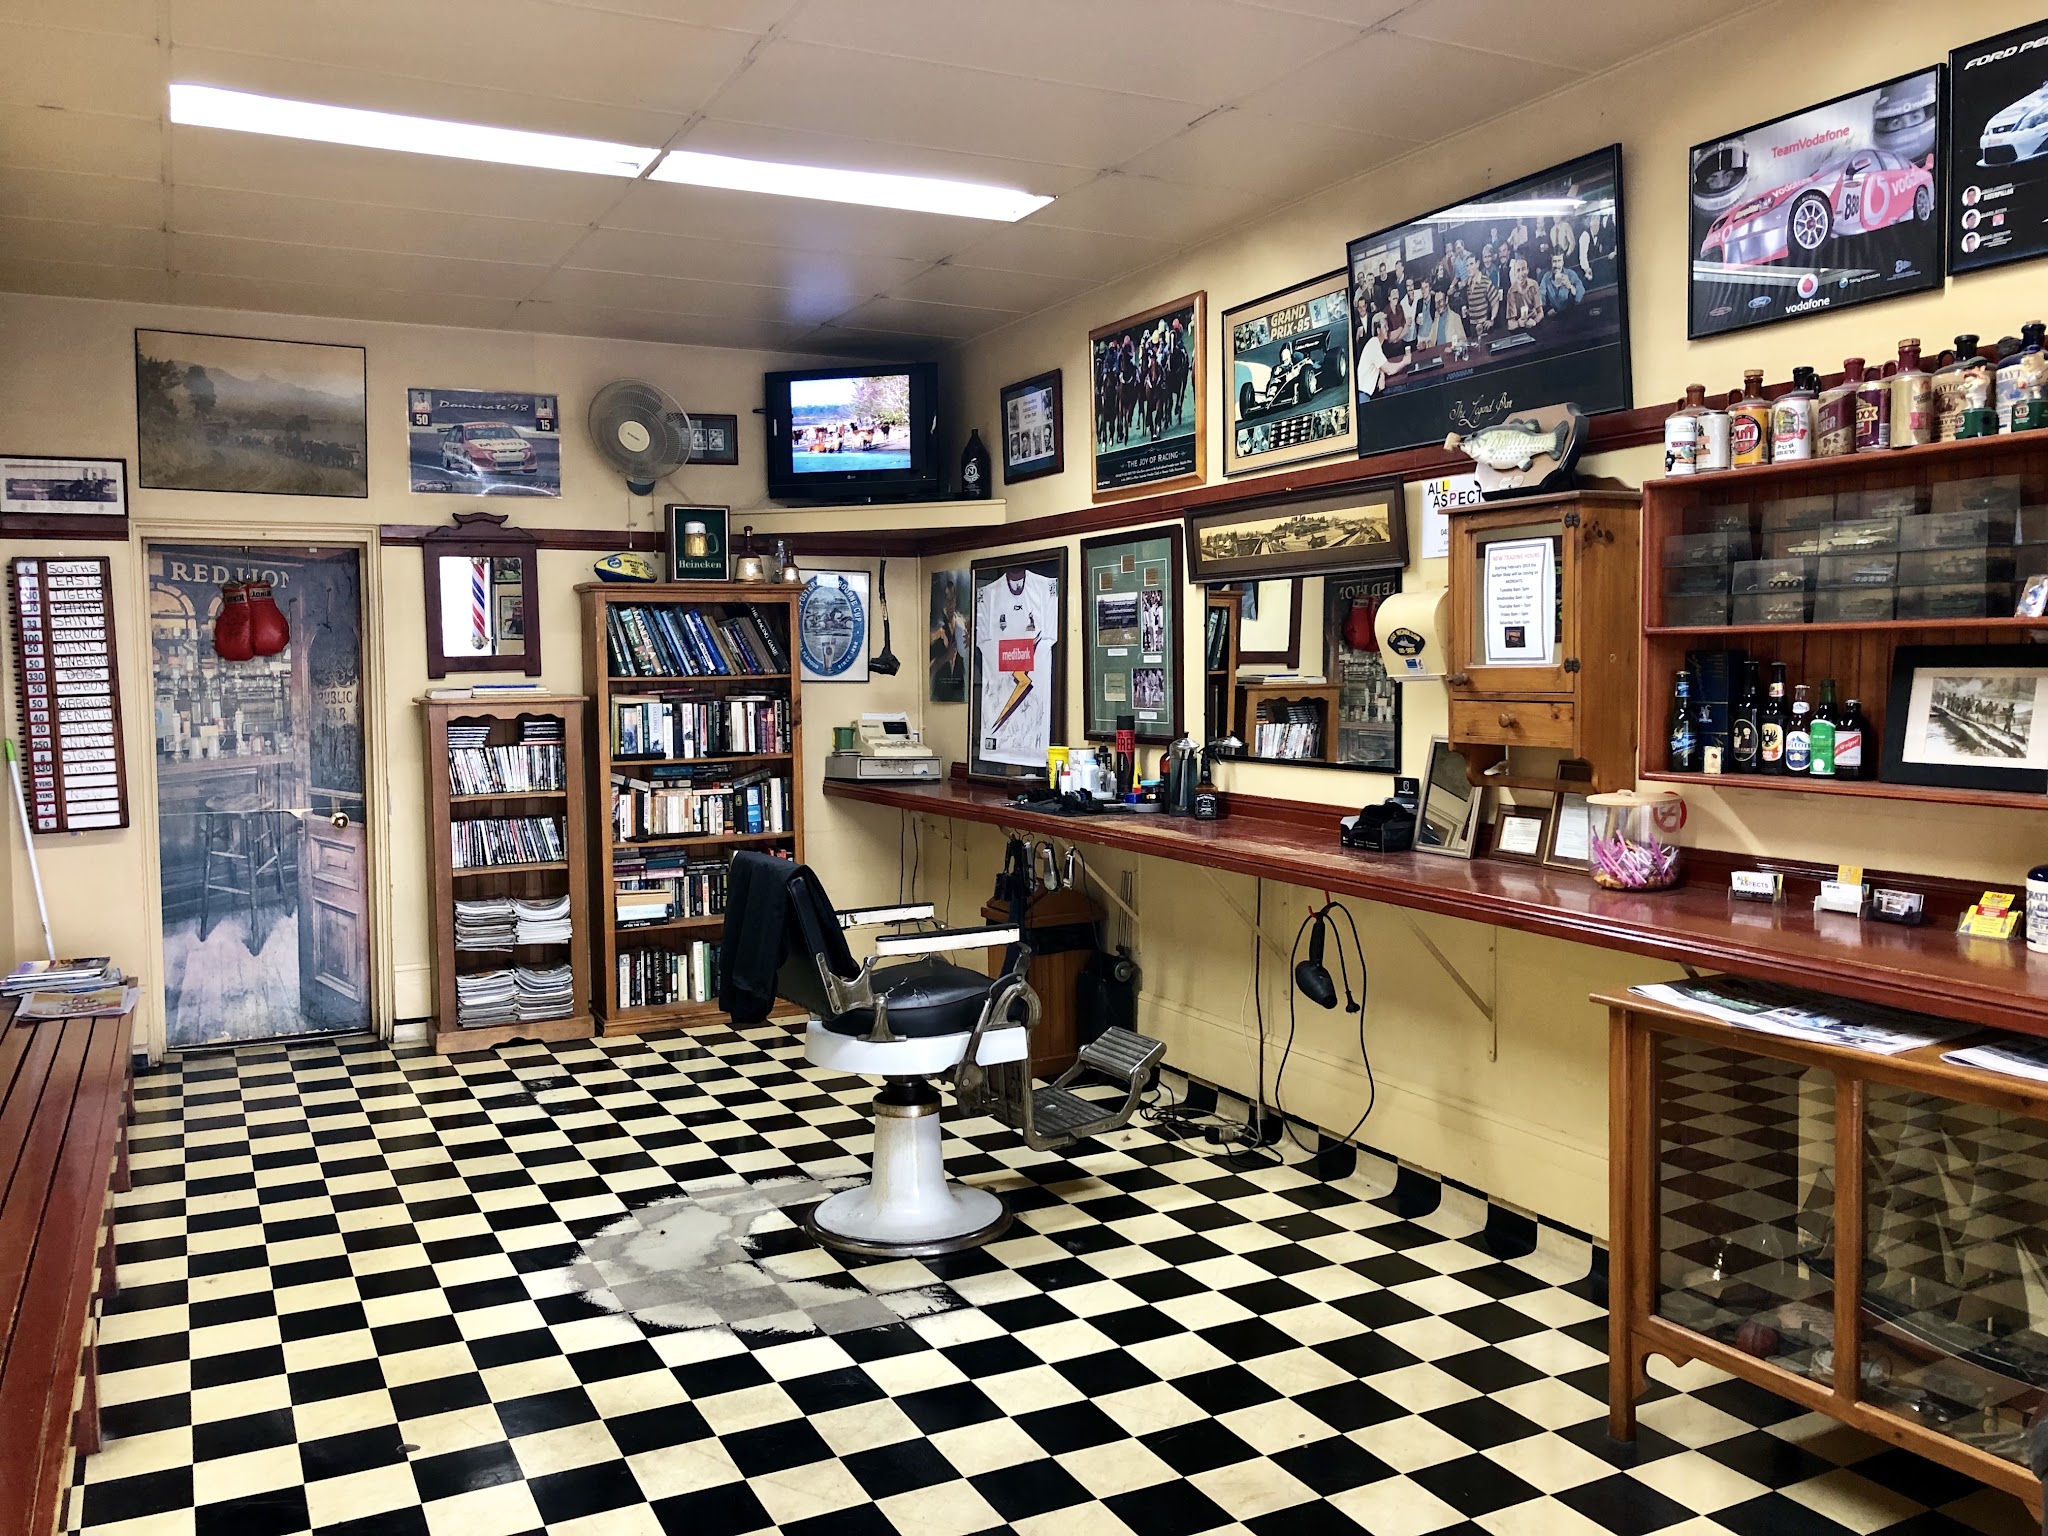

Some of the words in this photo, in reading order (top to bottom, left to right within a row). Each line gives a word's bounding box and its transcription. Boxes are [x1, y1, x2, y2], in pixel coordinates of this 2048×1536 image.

[1964, 46, 2018, 71] FORD
[1771, 126, 1850, 159] TeamVodafone
[1785, 296, 1831, 314] vodafone
[1270, 304, 1307, 328] GRAND
[416, 413, 429, 426] 50
[539, 419, 551, 431] 15
[1127, 459, 1138, 469] THE
[1138, 457, 1148, 467] JOY
[1149, 455, 1157, 464] OF
[1157, 451, 1179, 463] RACING
[1427, 480, 1449, 496] ALL
[1432, 490, 1482, 508] ASPECT
[48, 564, 99, 574] SOUTHS
[678, 559, 722, 569] Heineken
[170, 561, 230, 584] RED
[56, 576, 103, 587] EASTS
[54, 589, 104, 600] TIGERS
[26, 620, 37, 629] 33
[54, 615, 106, 627] SAINTS
[632, 610, 657, 660] MANDELA
[756, 618, 770, 640] RACING
[24, 634, 39, 642] 100
[27, 644, 39, 653] 50
[1002, 647, 1031, 661] medibank
[29, 660, 40, 668] 50
[28, 672, 44, 681] 330
[32, 685, 43, 693] 50
[317, 689, 354, 705] PUBLIC
[31, 699, 43, 708] 50
[33, 713, 45, 722] 40
[59, 709, 111, 721] PENRITH
[324, 707, 346, 721] BAR
[35, 725, 47, 733] 20
[60, 722, 114, 734] SHARKS
[1117, 737, 1135, 751] FREE
[63, 749, 108, 761] STORM
[44, 819, 50, 828] 6
[1740, 880, 1769, 889] ASPECTS
